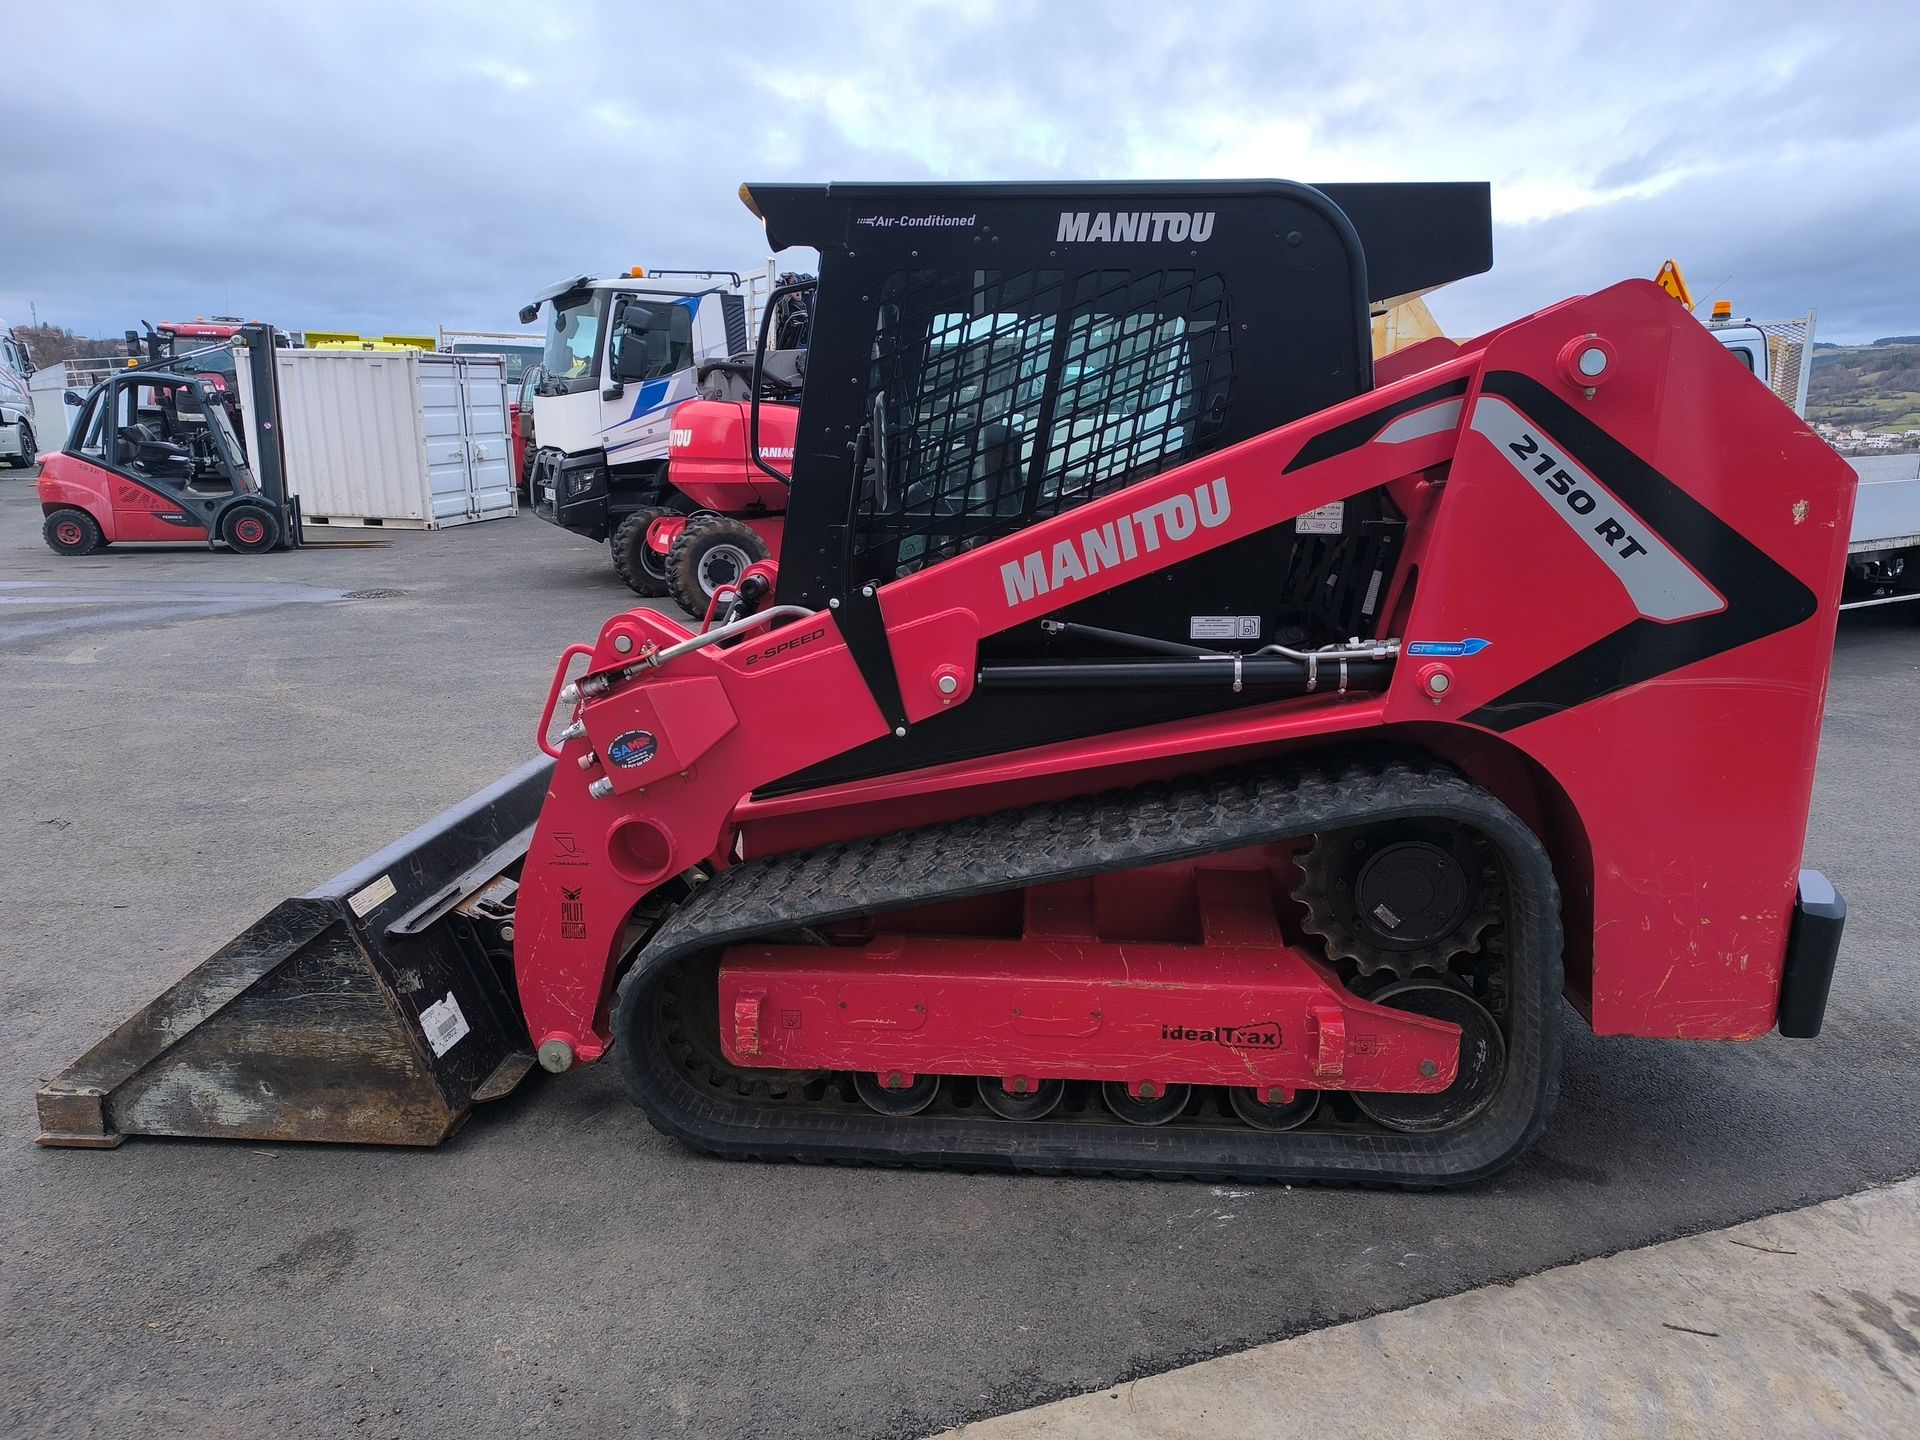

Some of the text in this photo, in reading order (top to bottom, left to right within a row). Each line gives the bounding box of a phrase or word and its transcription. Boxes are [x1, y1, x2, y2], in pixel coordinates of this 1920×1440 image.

[877, 214, 976, 227] Air-Conditioned
[1056, 212, 1215, 242] MANITOU
[1508, 434, 1648, 559] 2150 RT
[1000, 476, 1232, 607] MANITOU
[746, 628, 825, 666] 2-SPEED
[561, 902, 584, 921] PILOT
